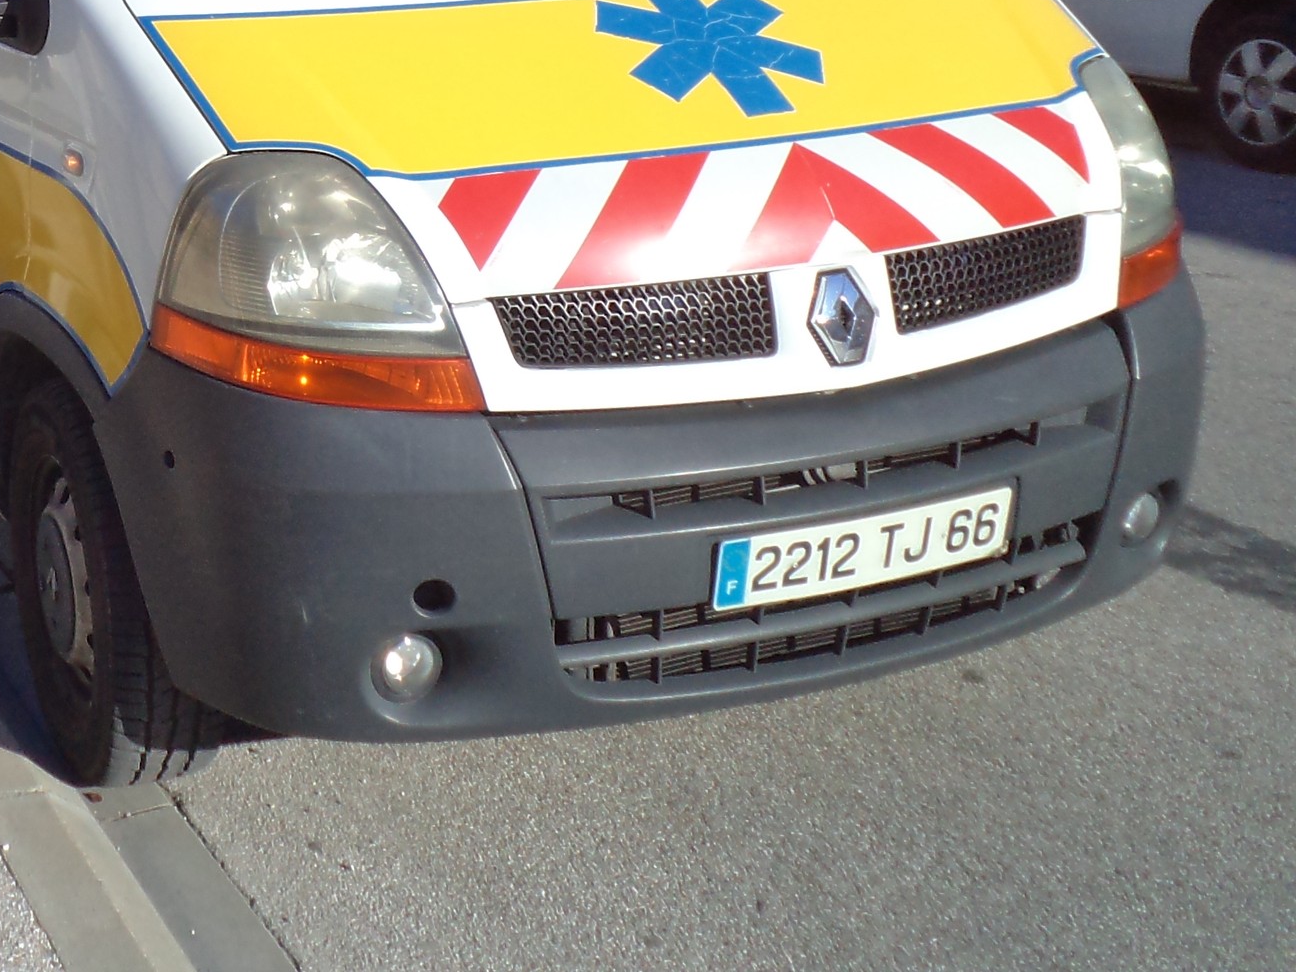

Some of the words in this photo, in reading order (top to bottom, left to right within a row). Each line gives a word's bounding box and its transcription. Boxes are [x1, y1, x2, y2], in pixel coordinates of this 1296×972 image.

[750, 532, 861, 592] 2212
[880, 516, 933, 569] TJ
[945, 502, 1000, 554] 66
[725, 578, 740, 596] F
